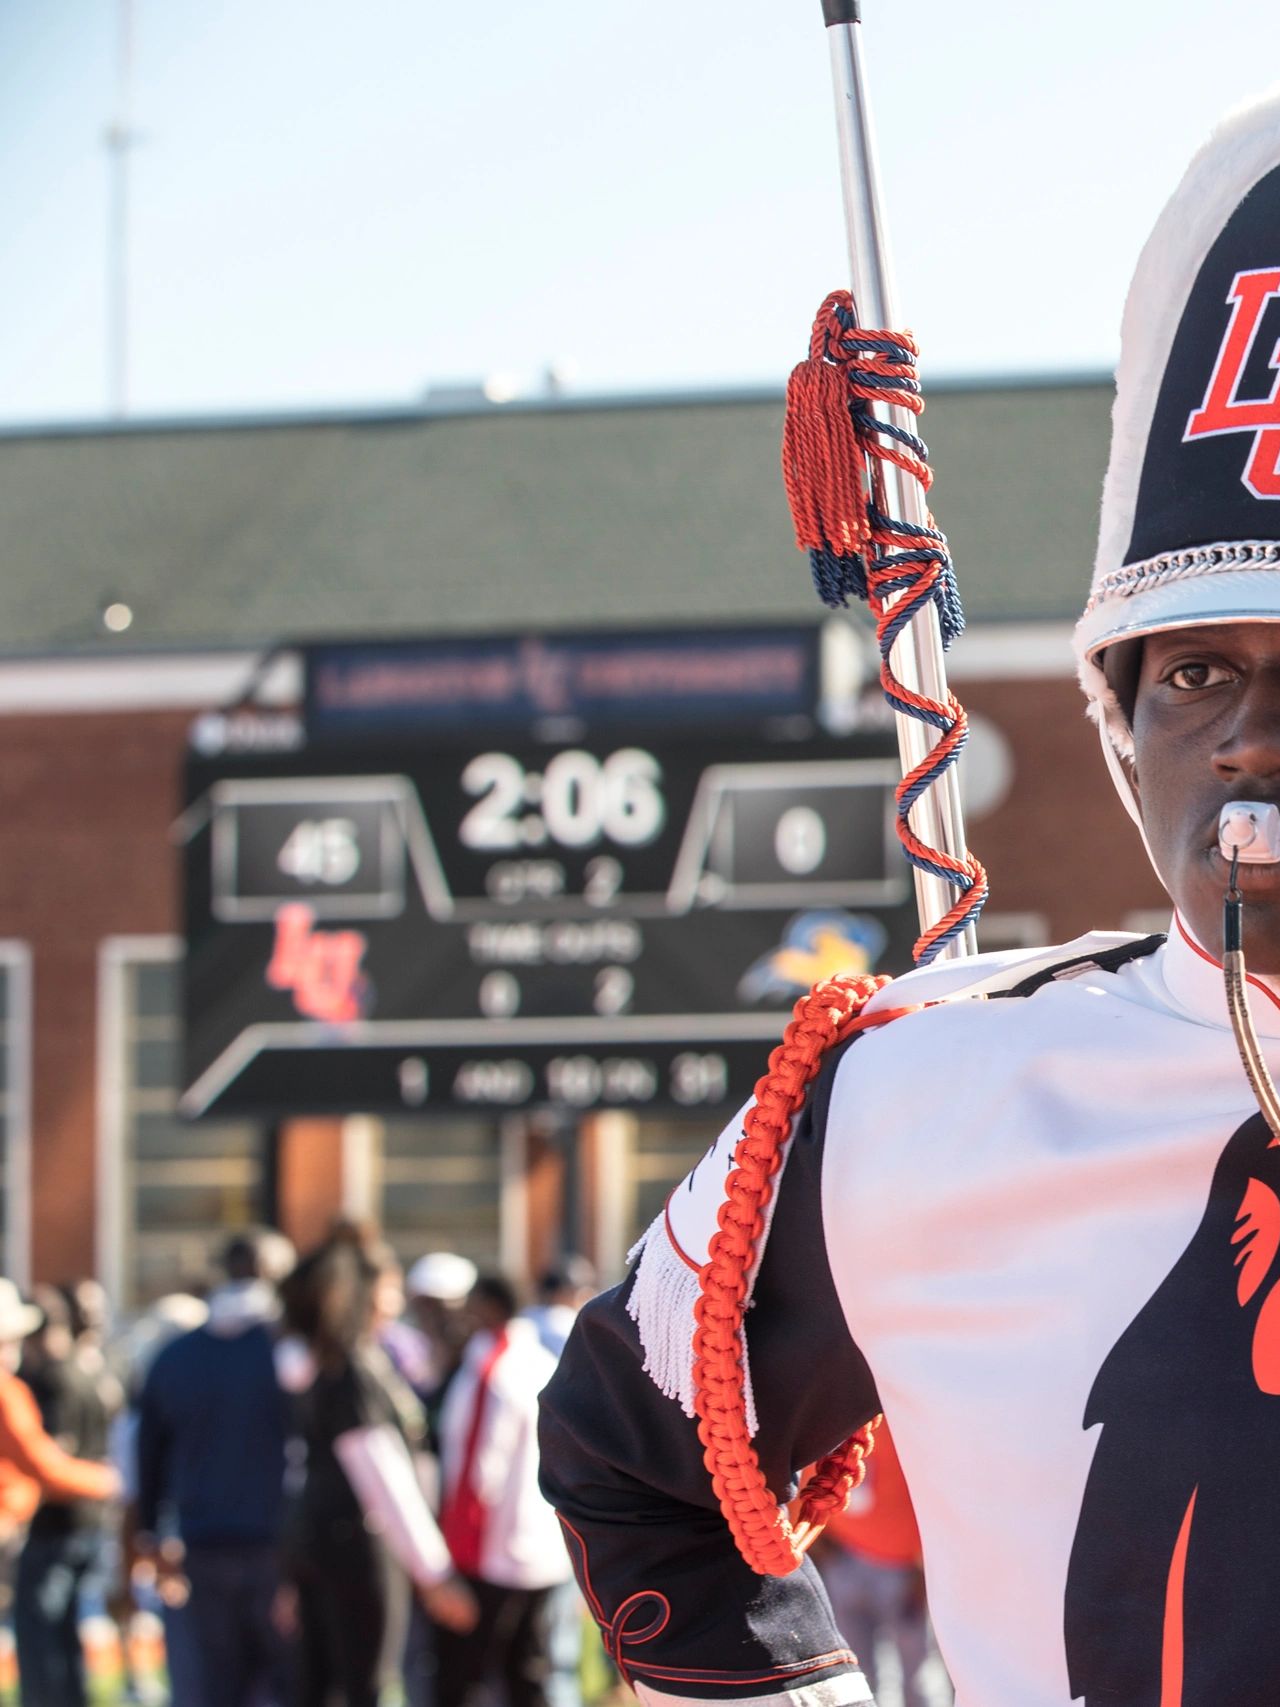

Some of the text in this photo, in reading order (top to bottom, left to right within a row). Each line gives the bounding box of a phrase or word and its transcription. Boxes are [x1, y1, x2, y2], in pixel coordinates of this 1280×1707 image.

[459, 748, 666, 849] 2:06
[775, 807, 826, 875] 0
[266, 902, 366, 1024] LU
